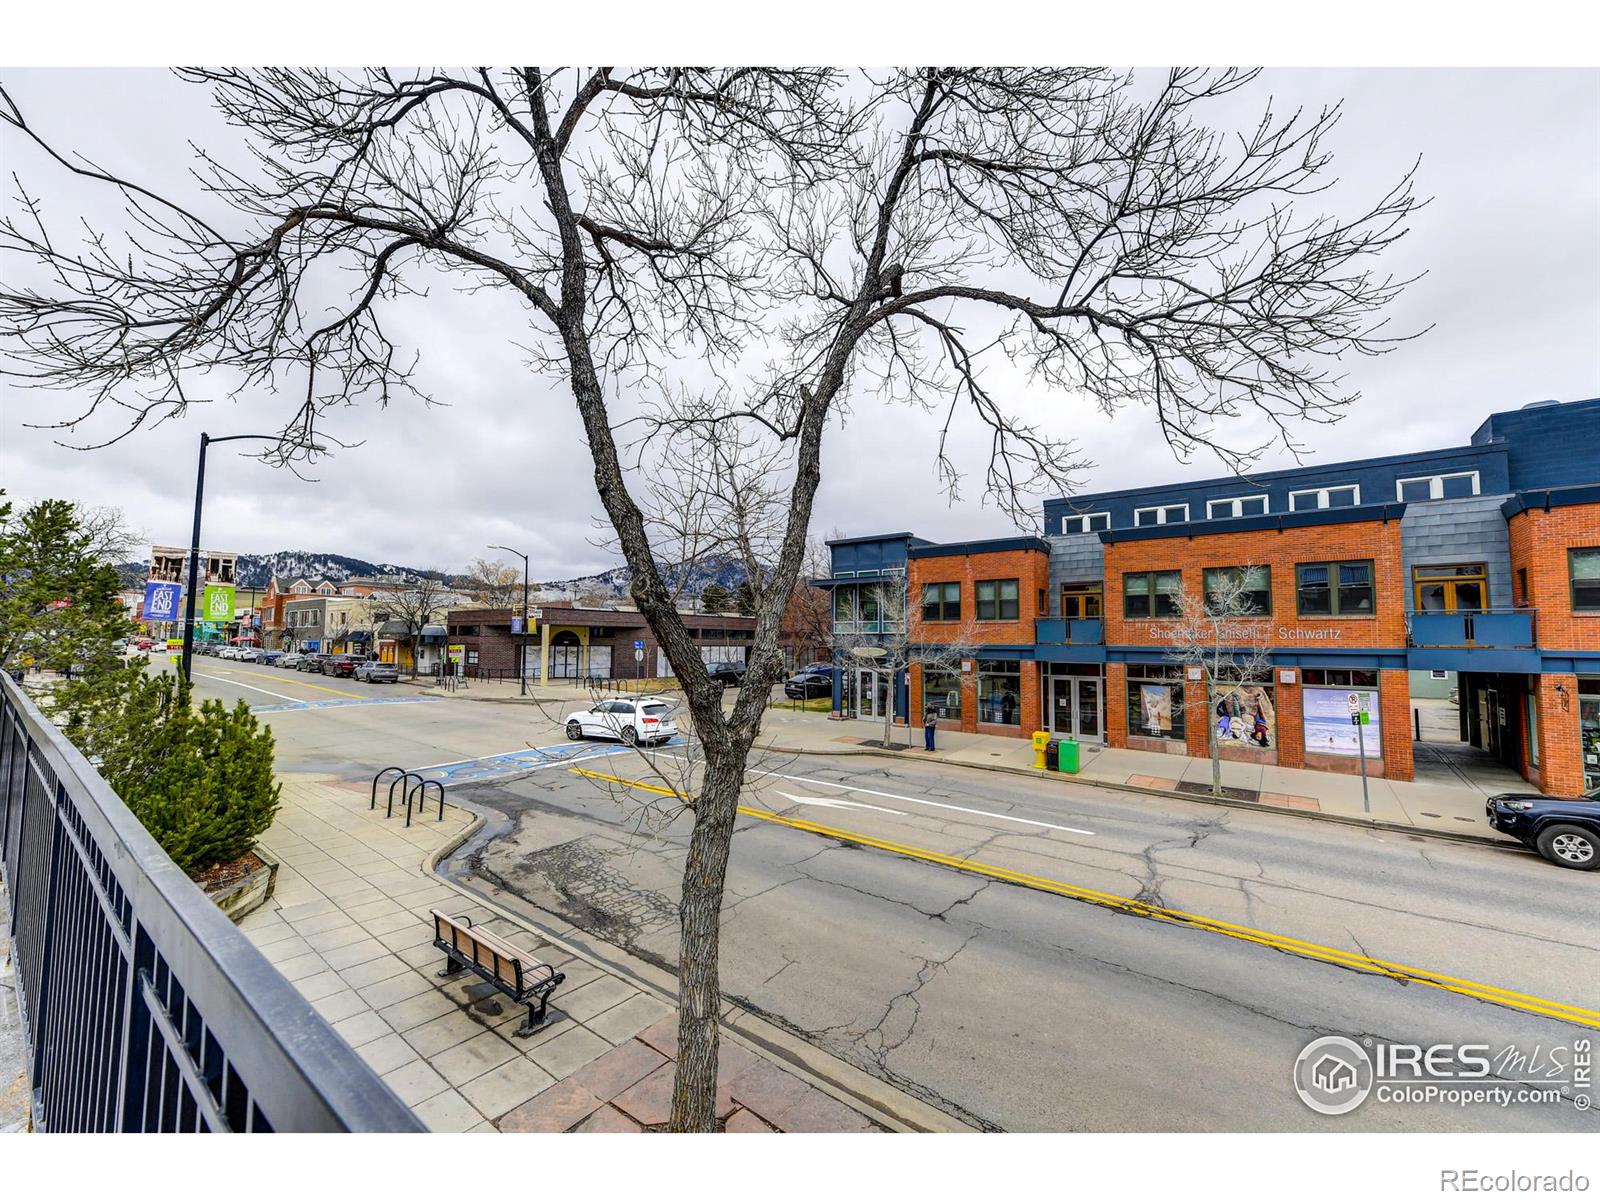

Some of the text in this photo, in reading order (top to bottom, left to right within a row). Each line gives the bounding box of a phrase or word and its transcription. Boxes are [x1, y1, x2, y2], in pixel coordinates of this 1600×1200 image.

[153, 590, 175, 601] EAST
[210, 593, 229, 603] EAST
[151, 599, 173, 611] END
[210, 602, 229, 612] END
[1278, 627, 1341, 640] Schwartz
